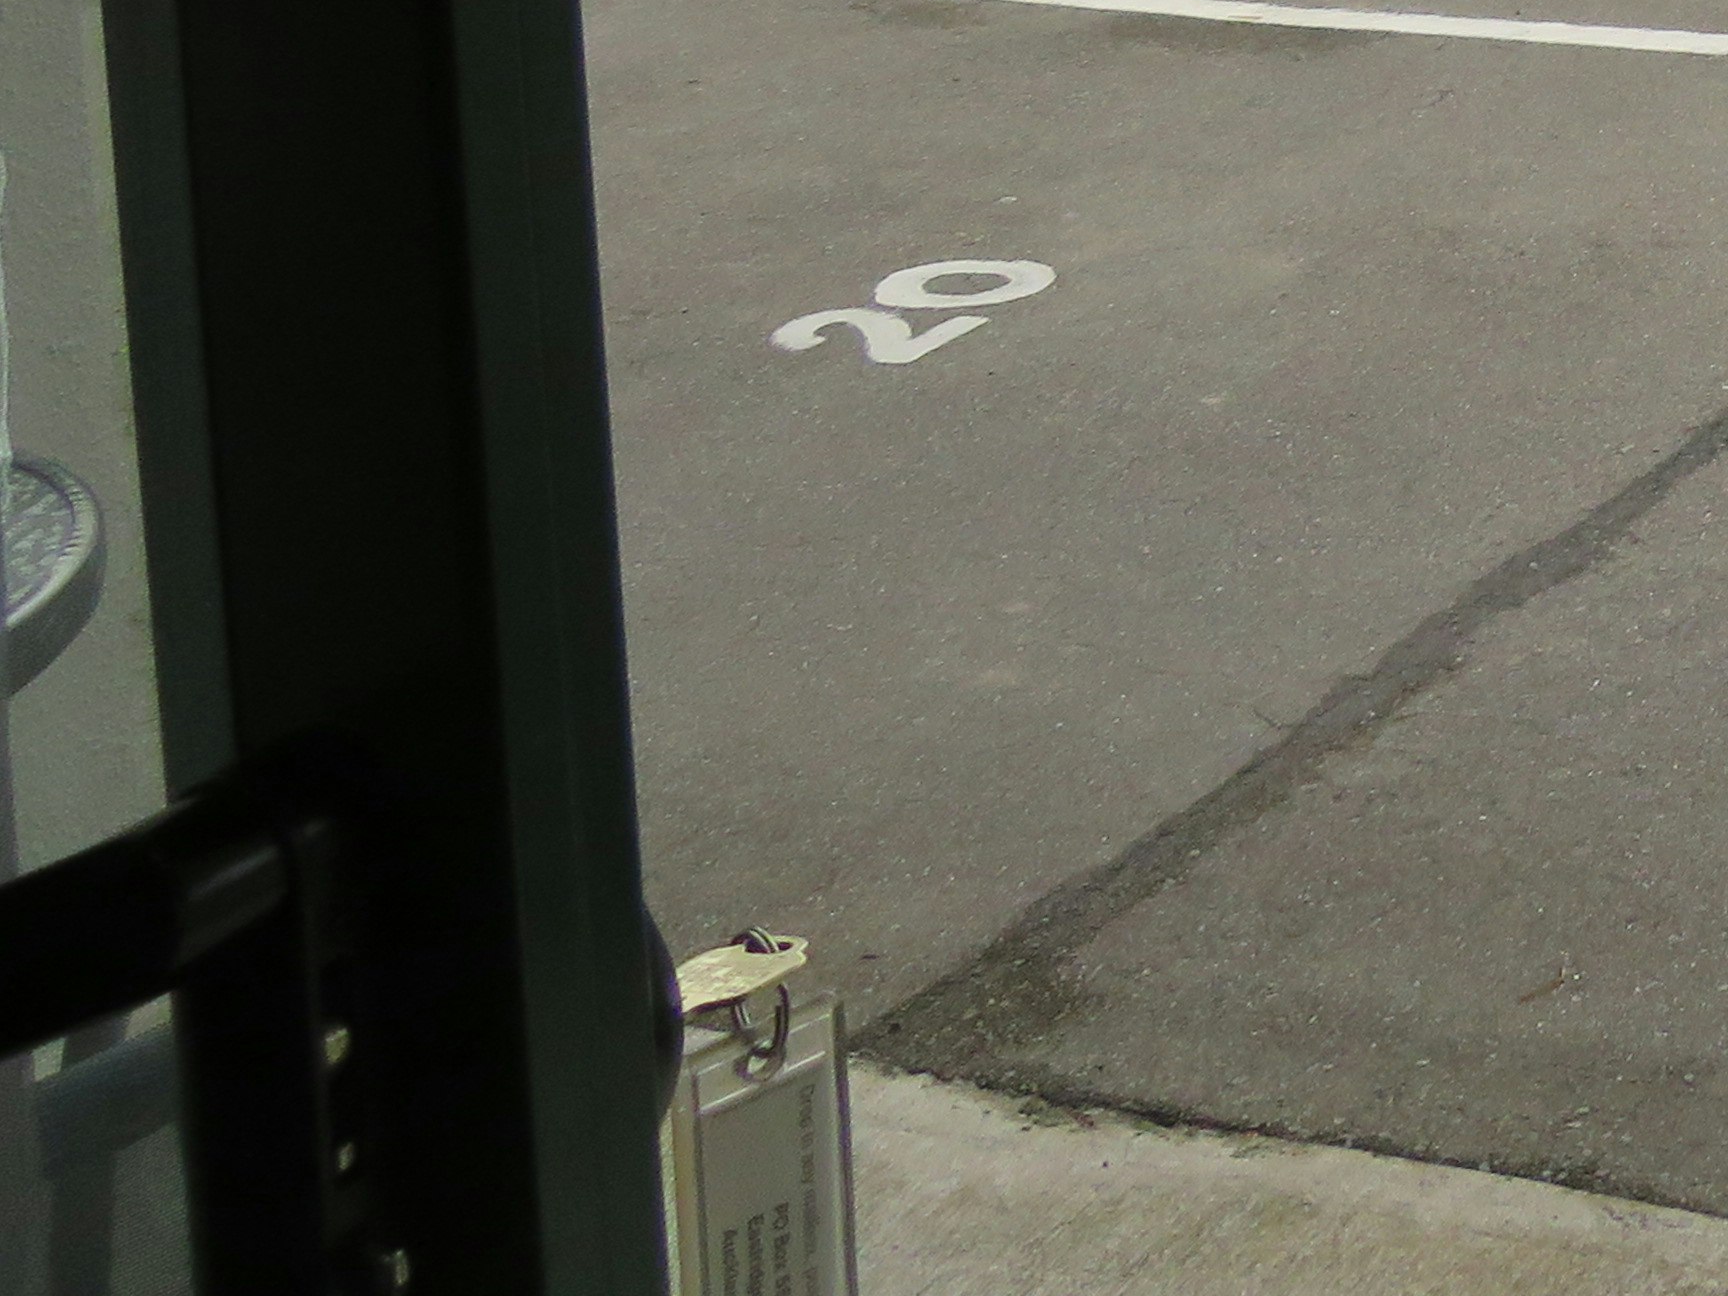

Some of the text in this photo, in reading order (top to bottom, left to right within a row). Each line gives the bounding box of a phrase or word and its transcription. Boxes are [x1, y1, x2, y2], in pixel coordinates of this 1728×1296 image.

[767, 259, 1057, 363] 20
[773, 1202, 789, 1230] PO
[774, 1231, 791, 1269] Box
